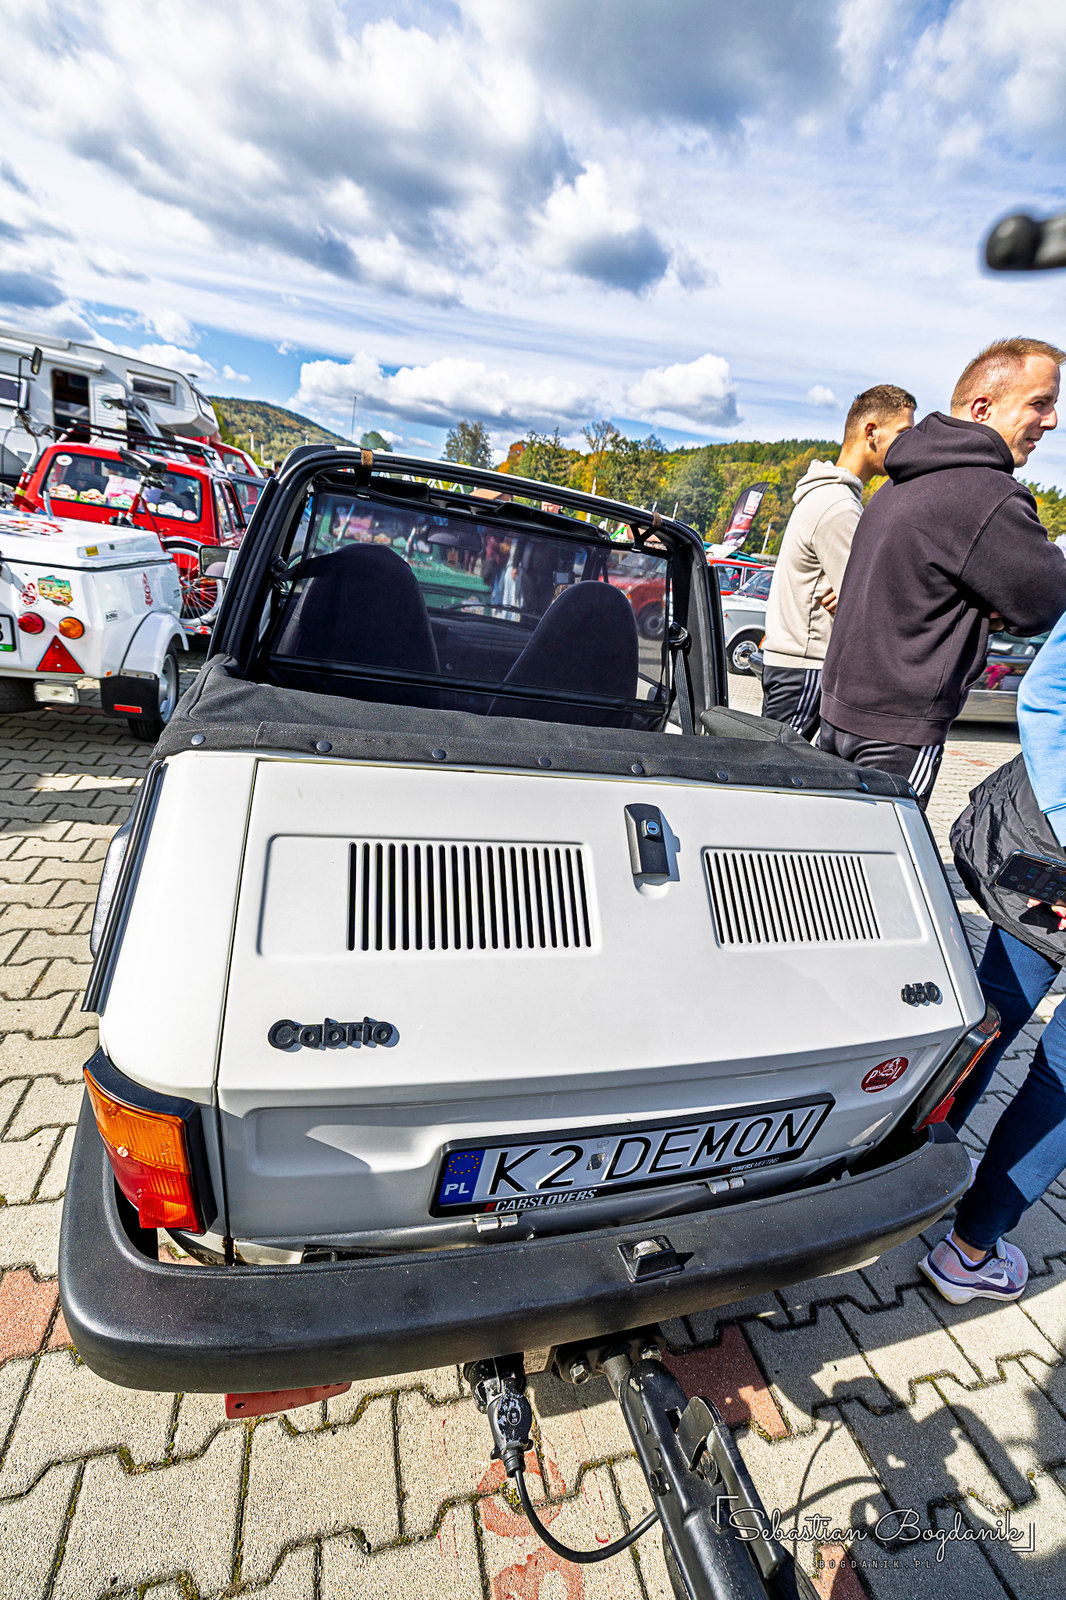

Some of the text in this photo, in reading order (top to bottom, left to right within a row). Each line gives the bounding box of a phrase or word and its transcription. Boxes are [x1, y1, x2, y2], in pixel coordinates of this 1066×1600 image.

[268, 1016, 394, 1050] Cabrio
[488, 1108, 816, 1195] K2 DEMON
[444, 1182, 470, 1196] PL
[484, 1189, 597, 1213] #CARSLOVERS
